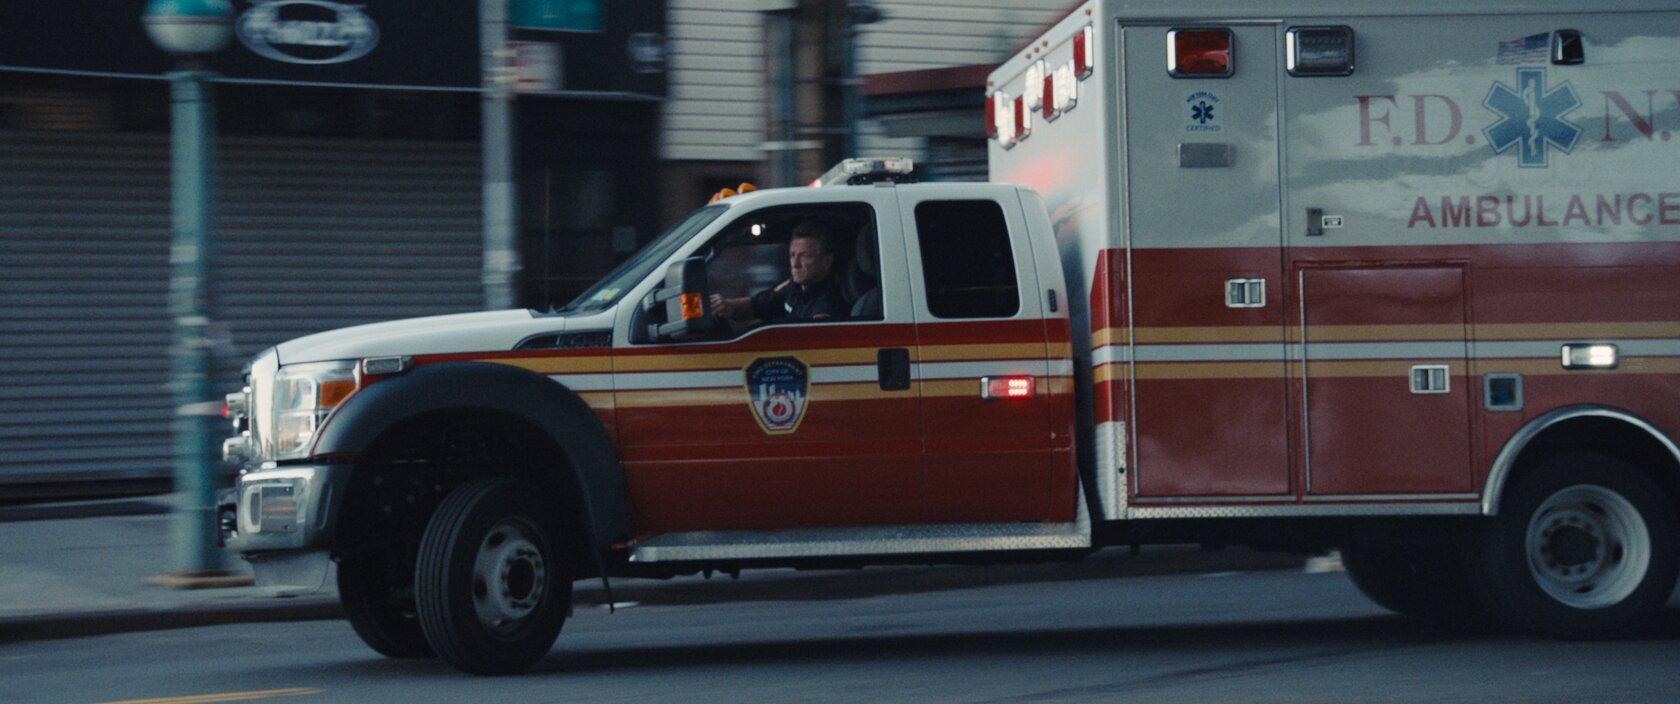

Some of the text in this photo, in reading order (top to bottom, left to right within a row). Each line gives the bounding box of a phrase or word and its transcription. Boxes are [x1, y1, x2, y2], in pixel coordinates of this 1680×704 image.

[1353, 90, 1680, 146] F.D. N.
[1407, 192, 1680, 229] AMBULANCE
